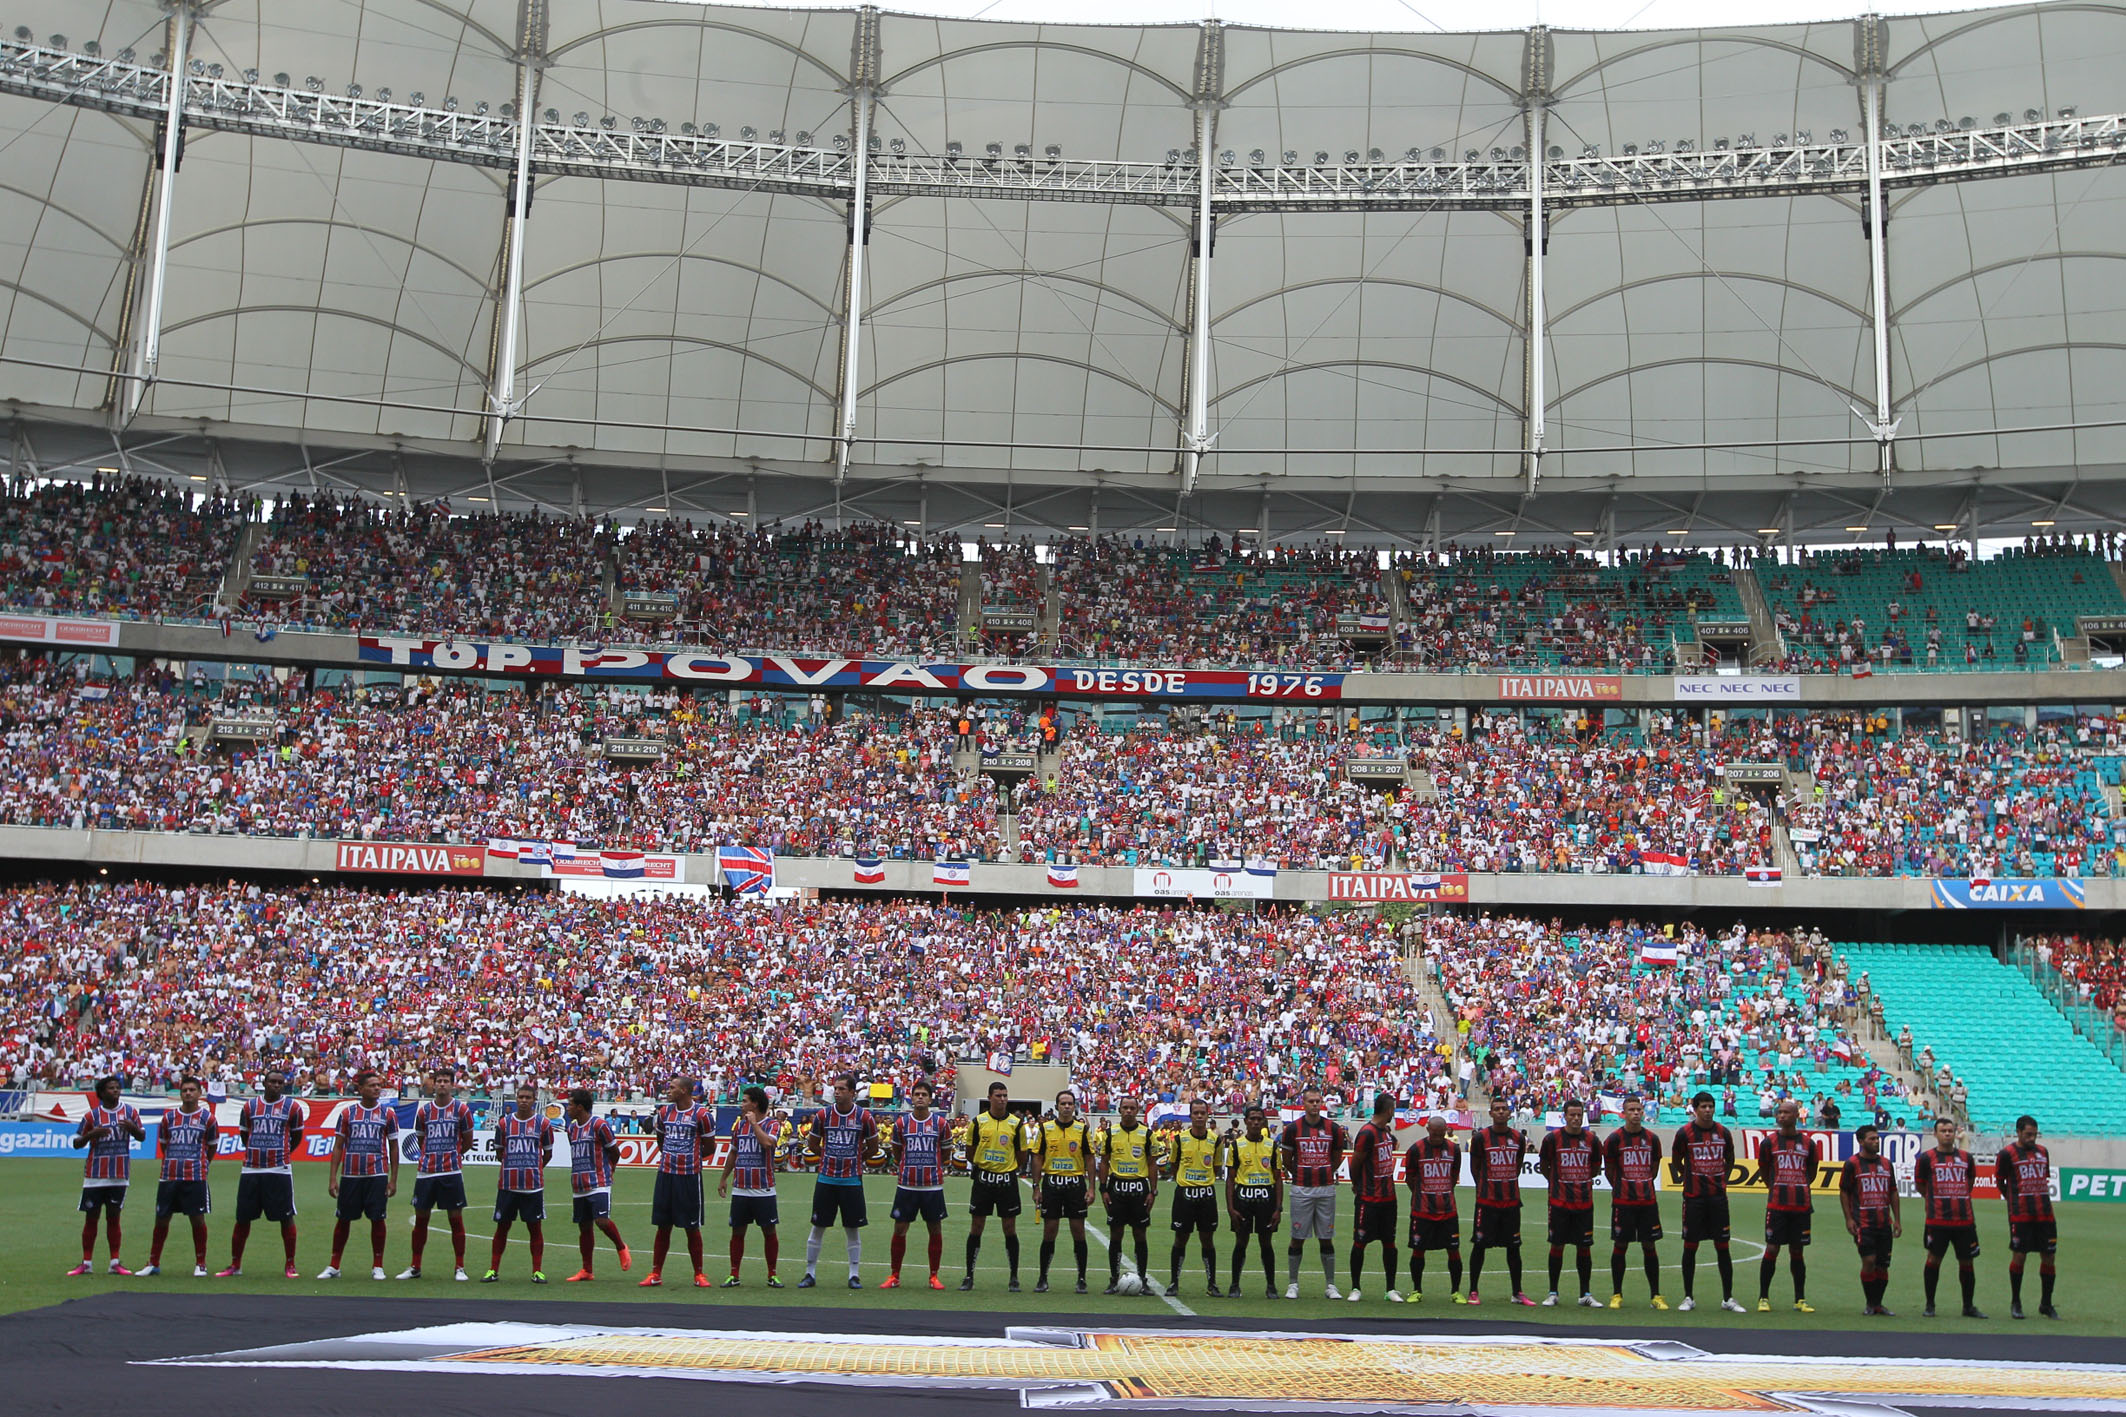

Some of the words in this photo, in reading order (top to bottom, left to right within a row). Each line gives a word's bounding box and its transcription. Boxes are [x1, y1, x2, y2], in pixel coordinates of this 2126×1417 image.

[254, 582, 269, 590] 412
[1072, 670, 1186, 693] DESDE
[1248, 674, 1324, 696] 1976
[1501, 678, 1595, 698] ITAIPAVA
[1679, 683, 1713, 693] NEC
[1720, 683, 1754, 693] NEC
[1761, 683, 1795, 693] NEC
[217, 725, 233, 734] 212
[255, 727, 270, 735] 211
[611, 744, 625, 752] 211
[642, 745, 658, 753] 210
[1351, 765, 1367, 773] 208
[1762, 770, 1780, 778] 206
[340, 845, 452, 871] ITAIPAVA
[1969, 885, 2045, 902] CAIXA
[1052, 1161, 1073, 1169] luiza
[1118, 1165, 1138, 1173] luiza
[981, 1171, 1010, 1184] LUPO
[1115, 1181, 1143, 1192] LUPO
[1185, 1186, 1213, 1198] LUPO
[1240, 1188, 1269, 1198] LUPO
